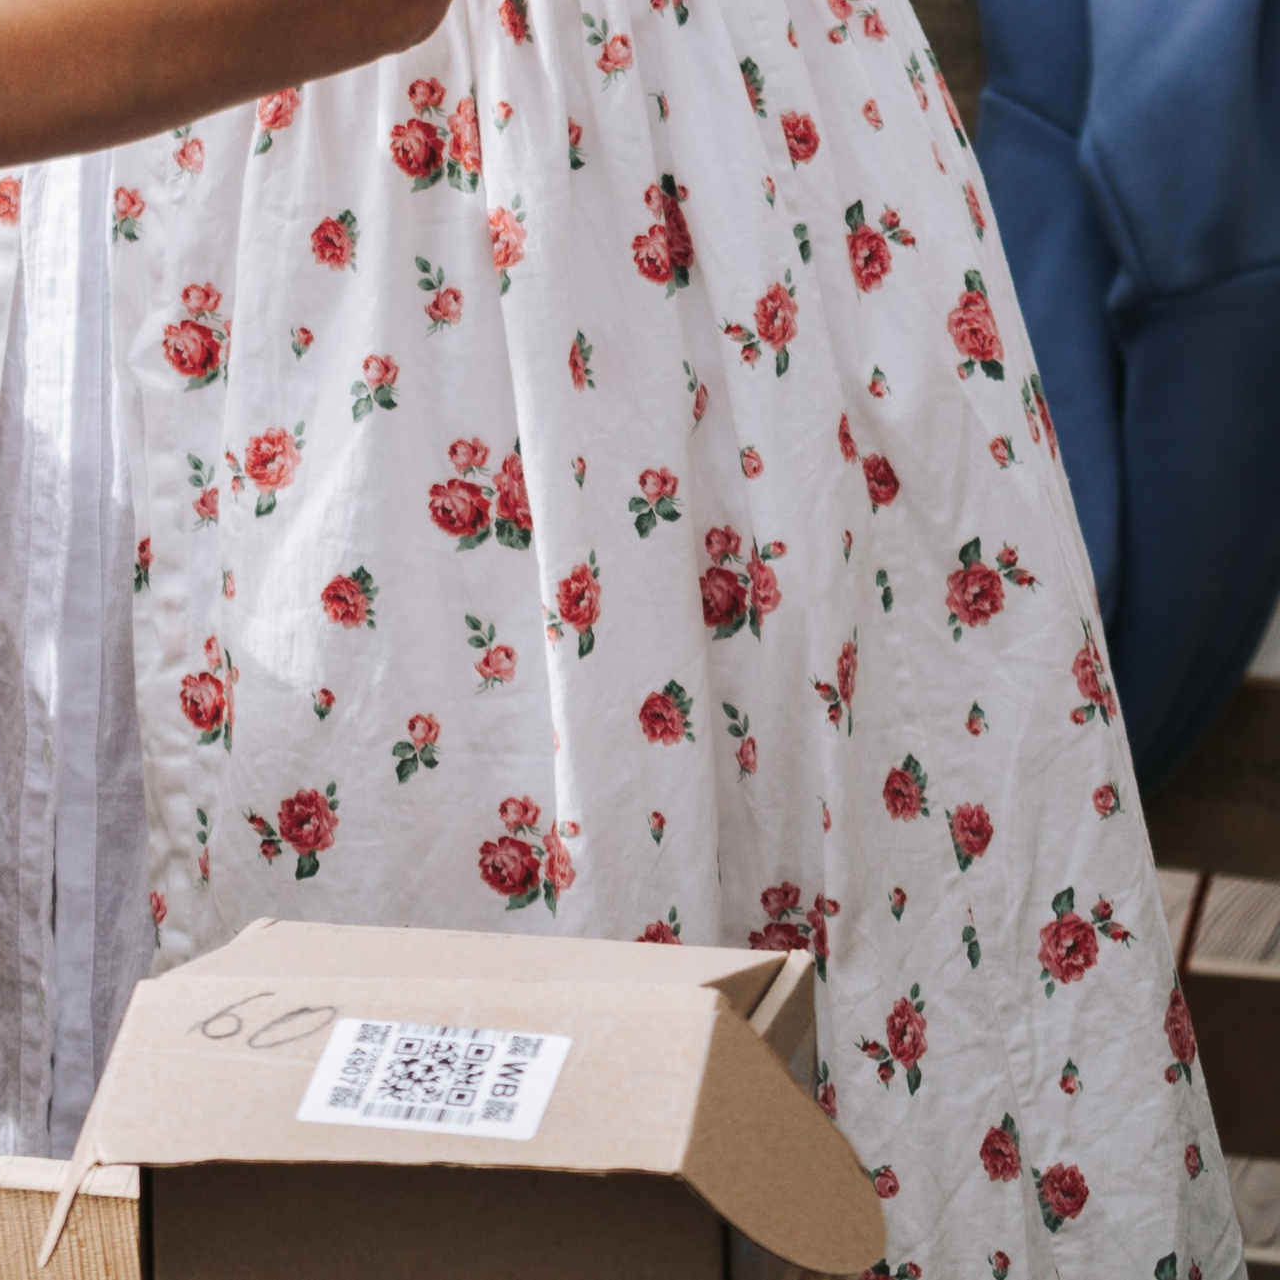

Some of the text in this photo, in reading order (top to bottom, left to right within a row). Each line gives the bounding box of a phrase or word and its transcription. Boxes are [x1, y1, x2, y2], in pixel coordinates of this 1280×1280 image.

[187, 992, 338, 1049] 60
[340, 1047, 368, 1085] 4907
[491, 1061, 529, 1098] WB
